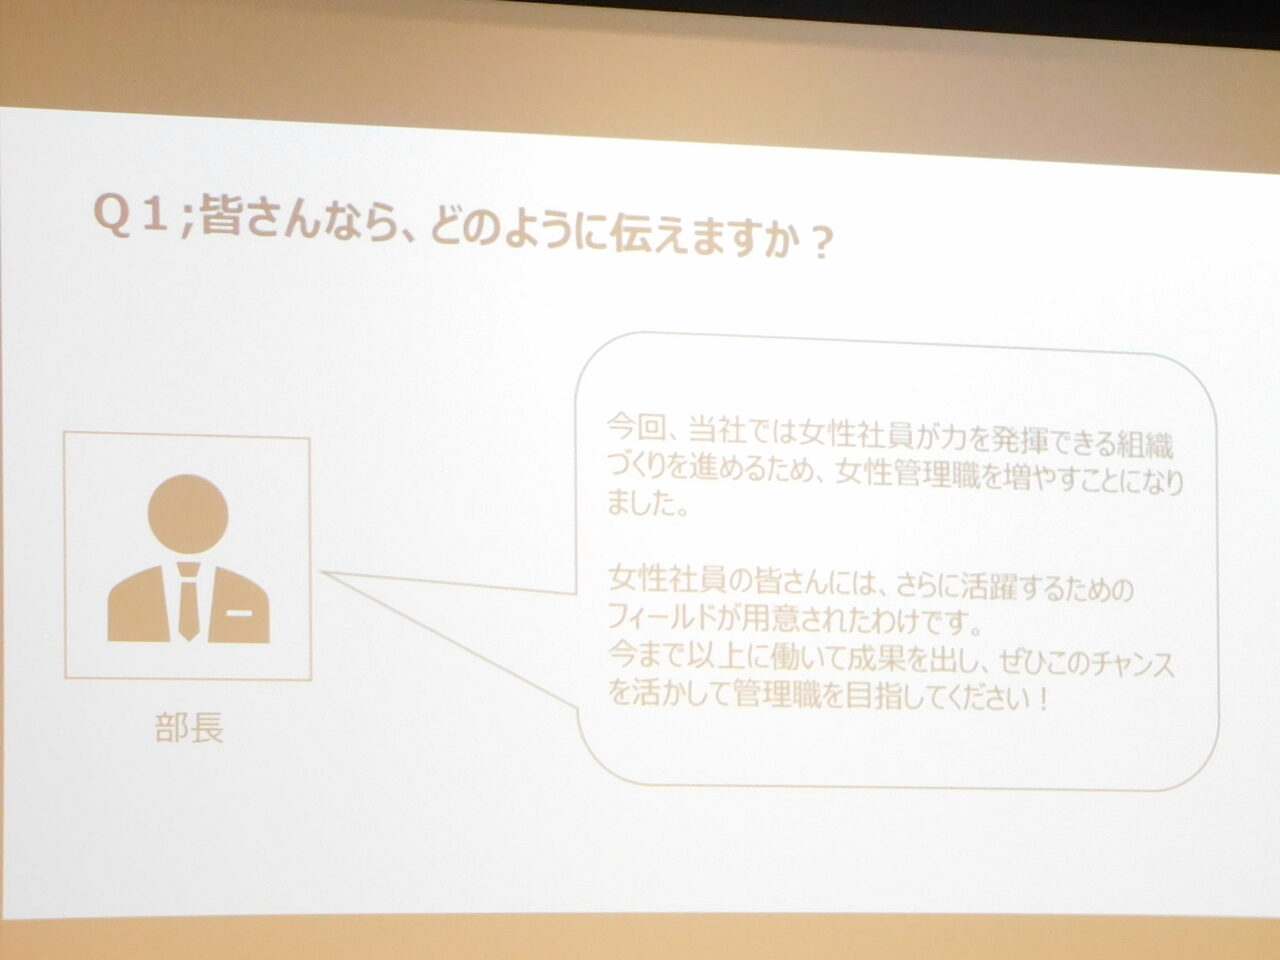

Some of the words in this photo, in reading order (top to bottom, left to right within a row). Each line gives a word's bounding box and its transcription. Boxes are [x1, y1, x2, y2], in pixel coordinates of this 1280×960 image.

[607, 411, 1175, 460] 今回、当社では女性社員が力を発揮できる組織
[607, 448, 1184, 497] づくりを進めるため、女性管理職を増やすことになり
[608, 488, 688, 518] ました。
[608, 562, 1135, 603] 女性社員の皆さんには、さらに活躍するための
[608, 602, 981, 638] フィールドが用意されたわけです。
[608, 638, 1176, 678] 今まで以上に働いて成果を出し、ぜひこのチャンス
[608, 677, 1048, 712] を活かして管理職を目指してください！
[154, 711, 224, 744] 部長
